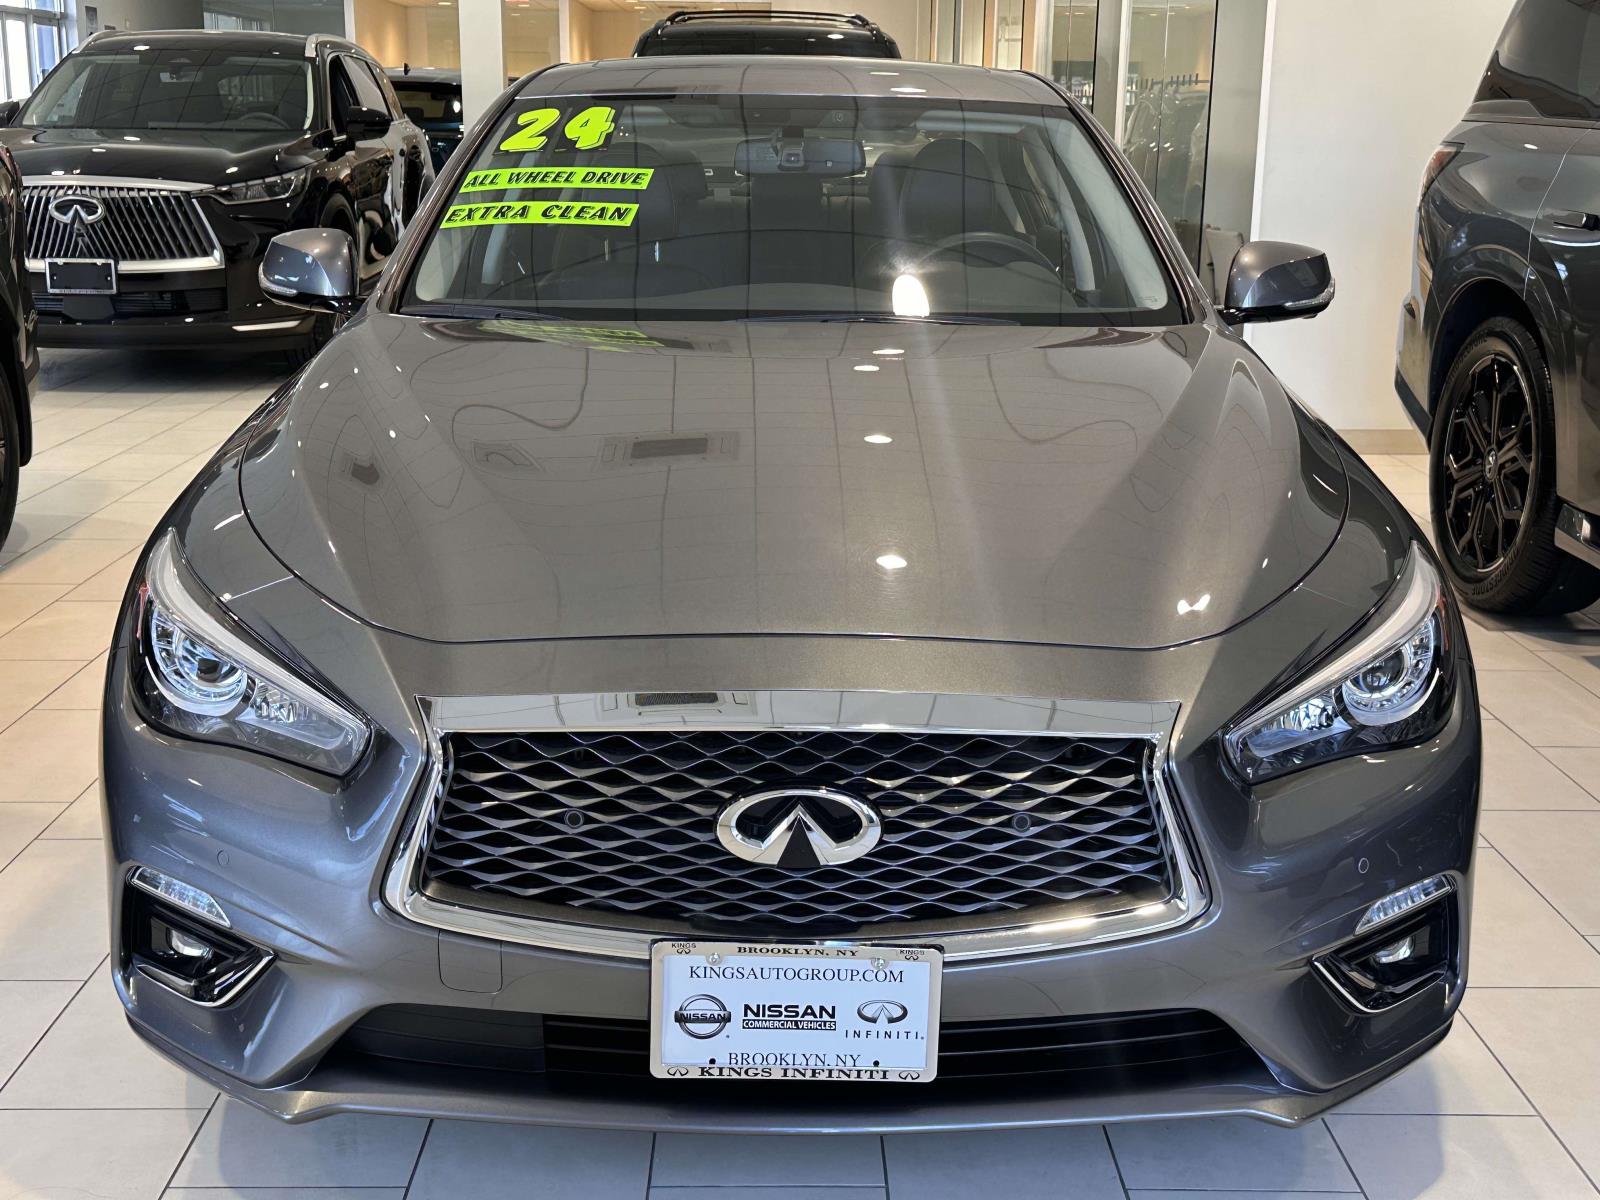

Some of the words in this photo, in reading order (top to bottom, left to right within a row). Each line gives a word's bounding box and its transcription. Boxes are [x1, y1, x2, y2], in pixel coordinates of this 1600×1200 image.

[499, 106, 616, 152] 24
[463, 173, 501, 189] ALL
[507, 171, 577, 185] WHEEL
[580, 171, 648, 186] DRIVE
[446, 204, 531, 223] EXTRA
[541, 204, 634, 221] CLEAN
[836, 949, 859, 957] NY
[689, 965, 905, 983] KINGSAUTOGROUP.COM
[680, 1013, 727, 1021] NISSAN
[743, 1003, 836, 1019] NISSAN
[743, 1020, 798, 1029] COMMERCIAL
[798, 1021, 836, 1030] VEHICLES
[845, 1029, 919, 1040] INFINITI
[835, 1053, 862, 1067] NY
[698, 1066, 772, 1078] KINGS
[781, 1068, 890, 1080] INFINITI
